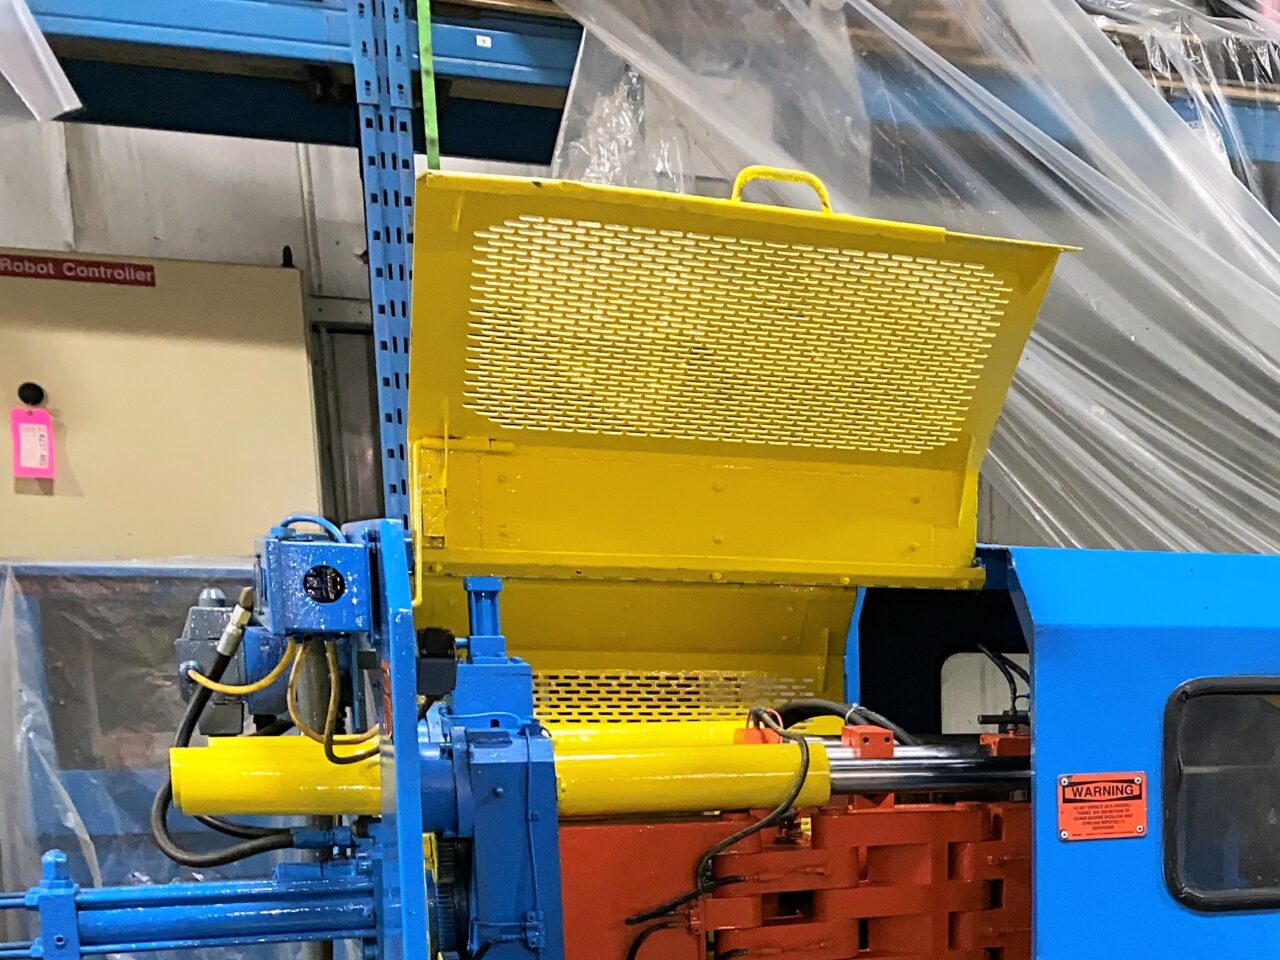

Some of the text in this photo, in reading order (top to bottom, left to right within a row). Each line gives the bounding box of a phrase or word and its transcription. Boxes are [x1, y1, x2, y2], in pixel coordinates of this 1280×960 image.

[0, 257, 154, 282] Robot Controller
[1071, 784, 1134, 798] WARNING
